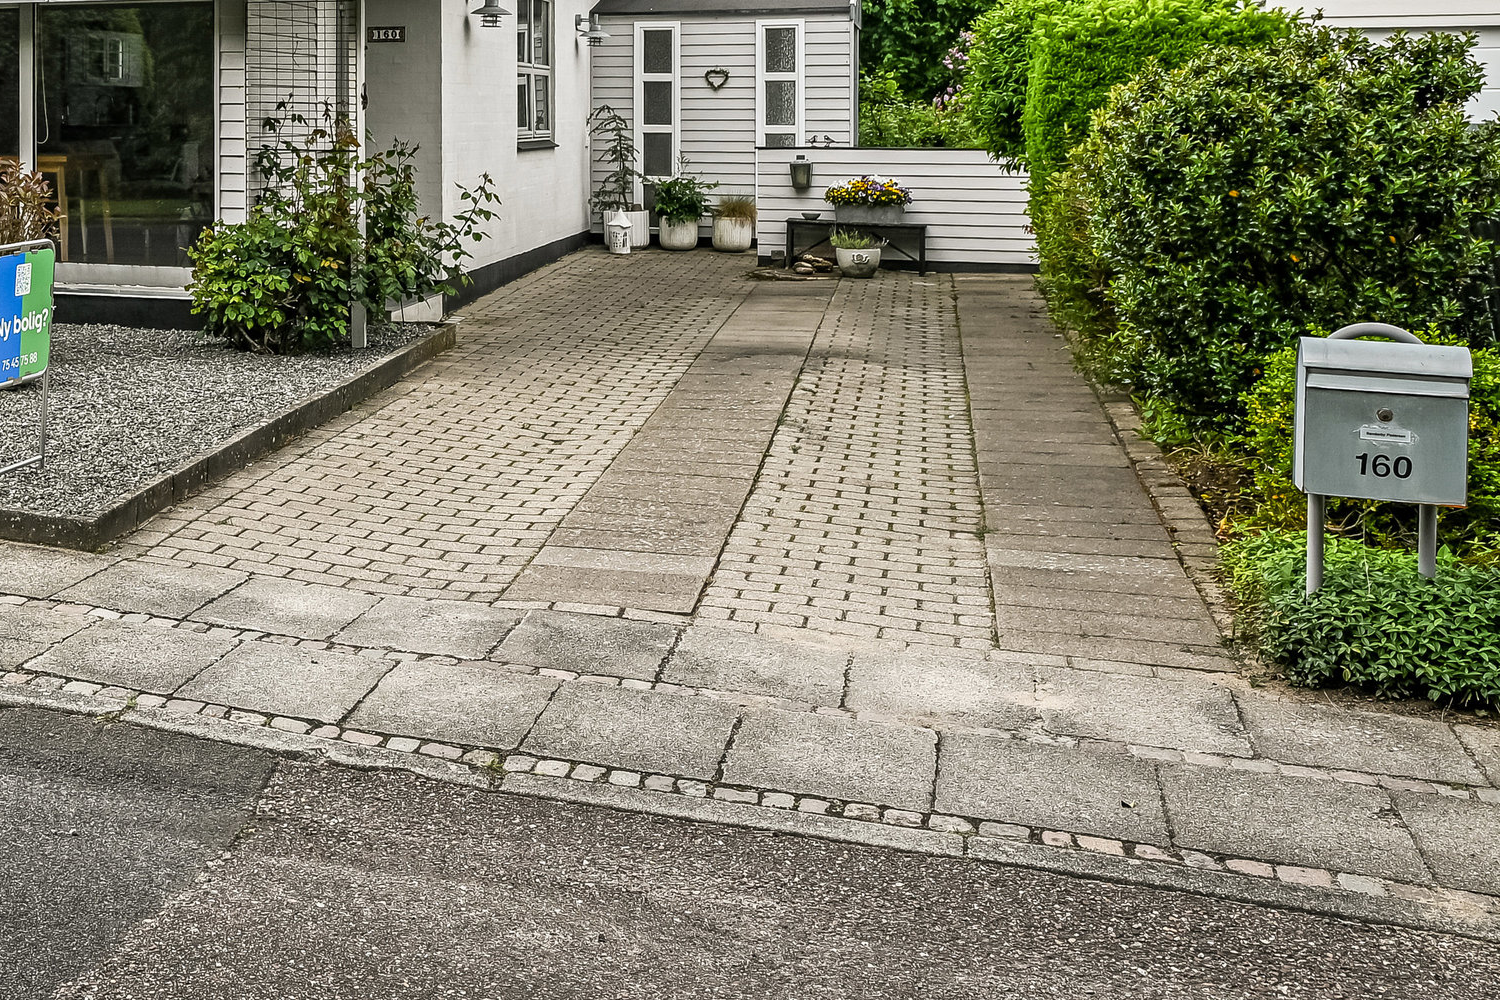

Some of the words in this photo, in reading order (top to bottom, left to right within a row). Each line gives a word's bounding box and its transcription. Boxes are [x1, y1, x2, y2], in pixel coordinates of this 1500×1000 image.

[376, 29, 398, 39] 160
[13, 308, 49, 334] bolig?
[2, 359, 11, 372] 75
[11, 356, 20, 368] 45
[20, 354, 29, 366] 75
[29, 352, 38, 364] 88
[1355, 452, 1413, 479] 160
